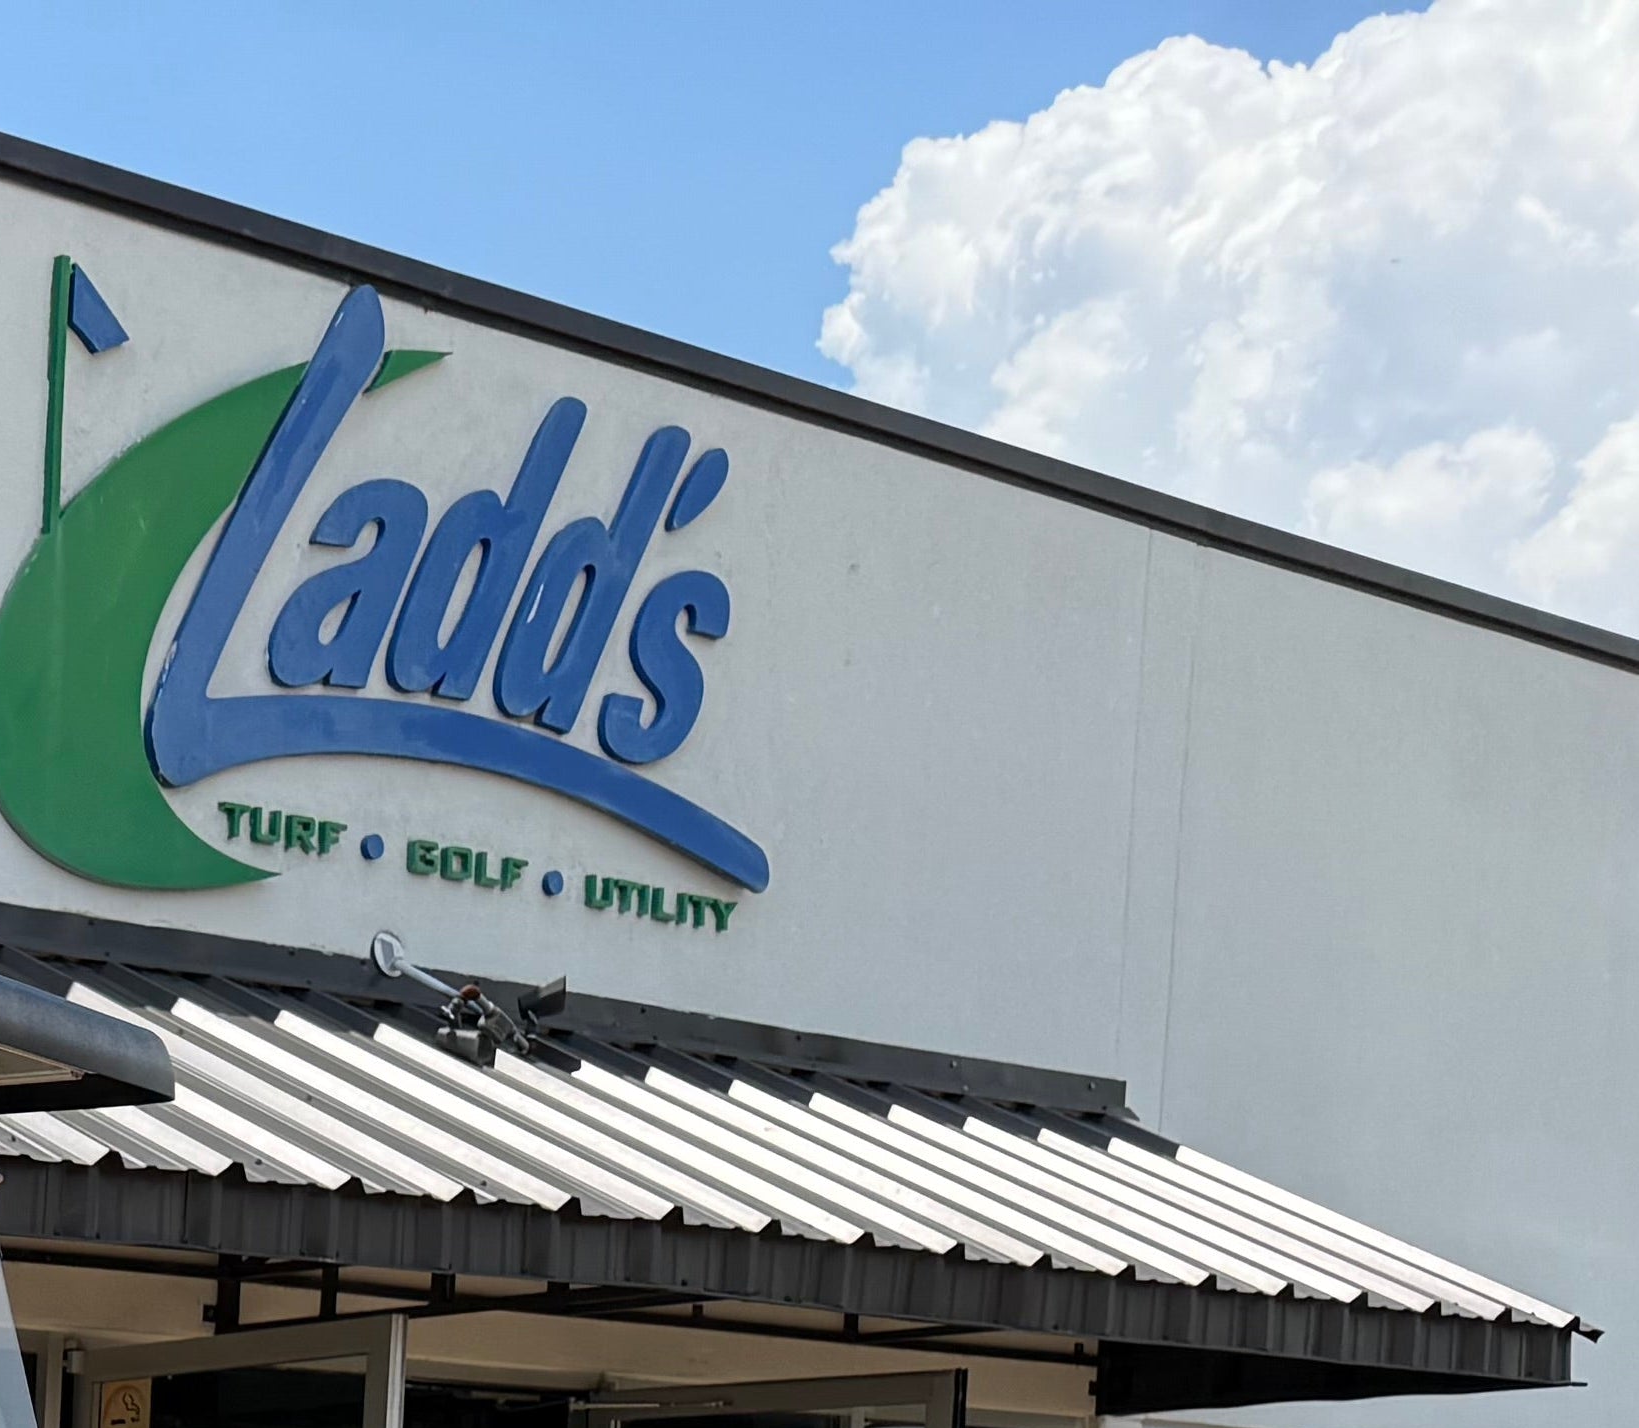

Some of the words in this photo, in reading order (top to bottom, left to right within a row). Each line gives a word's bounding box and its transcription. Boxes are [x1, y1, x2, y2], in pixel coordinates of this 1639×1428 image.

[144, 284, 733, 790] Ladd's
[218, 801, 348, 856] TURF
[406, 839, 529, 891] GOLF
[583, 874, 738, 932] UTILITY
